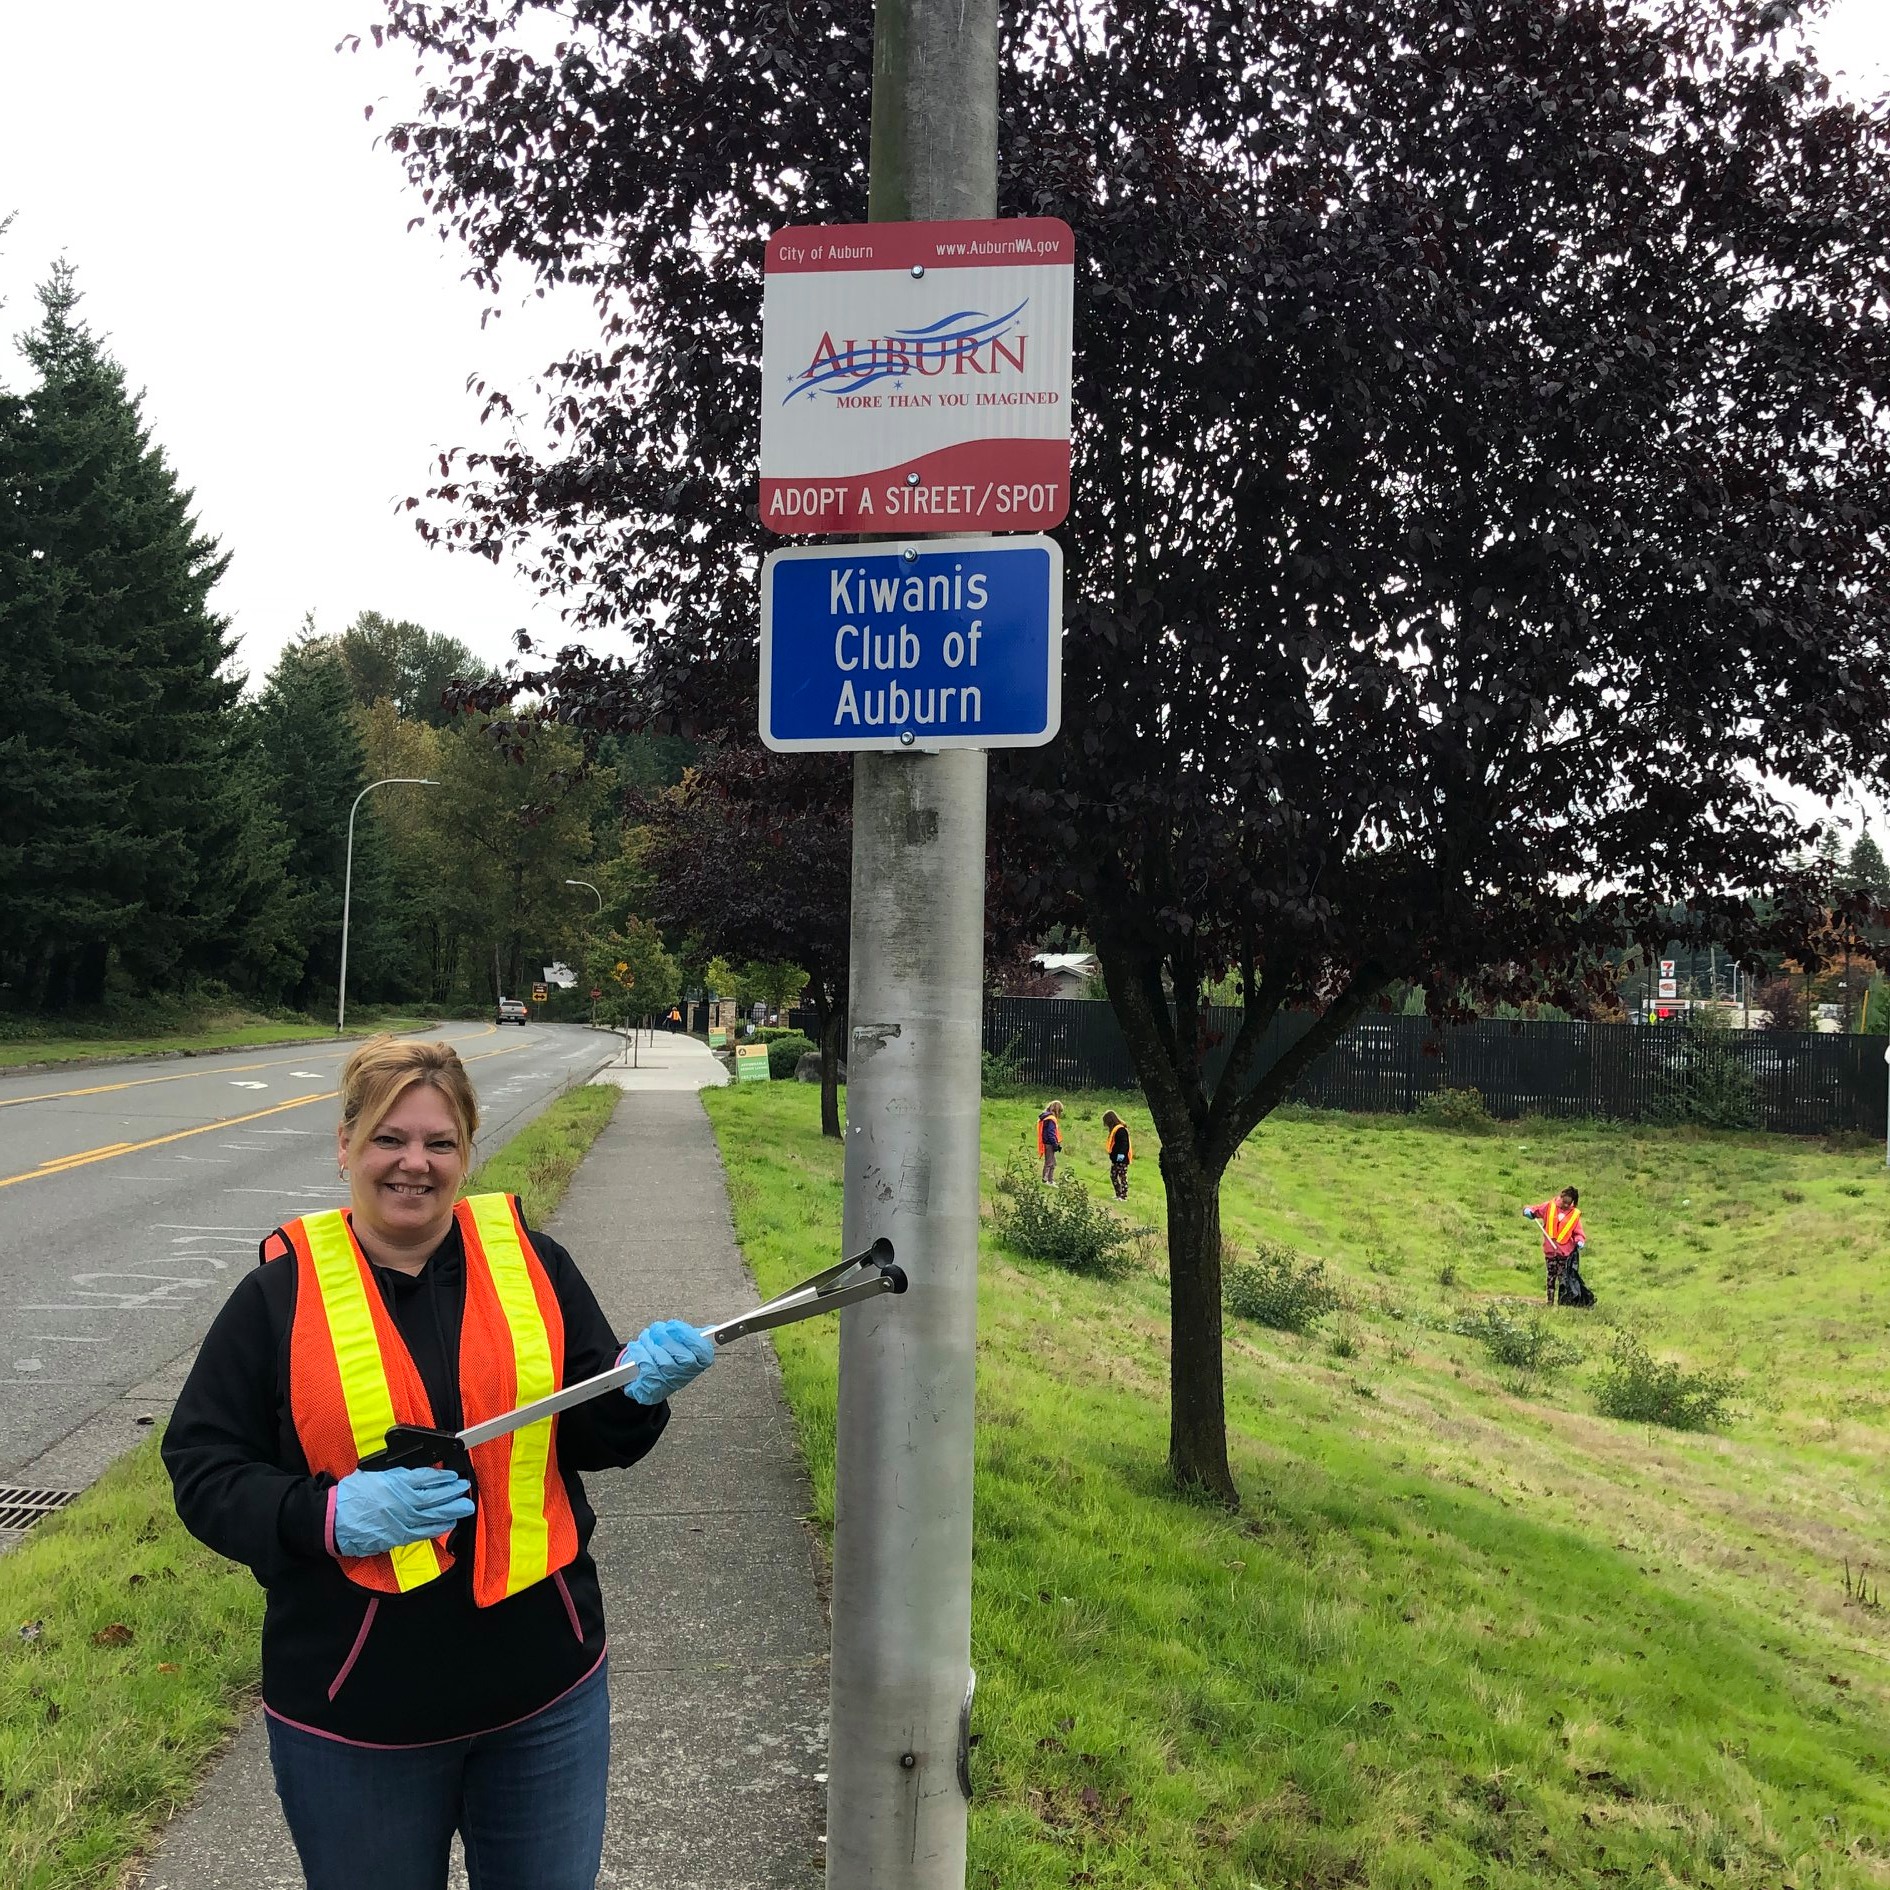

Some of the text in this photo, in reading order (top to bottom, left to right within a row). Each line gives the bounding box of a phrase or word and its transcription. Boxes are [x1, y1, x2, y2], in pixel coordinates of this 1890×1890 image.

[779, 245, 873, 264] City of Auburn
[936, 238, 1060, 257] www.AuburnWA.gov
[801, 330, 1029, 379] AUBURN
[836, 391, 1059, 409] MORE THAN YOU IMAGINED
[769, 482, 1059, 516] ADOPT A STREET/SPOT
[829, 563, 989, 615] Kiwanis
[834, 620, 983, 672] Club of
[833, 679, 982, 726] Auburn
